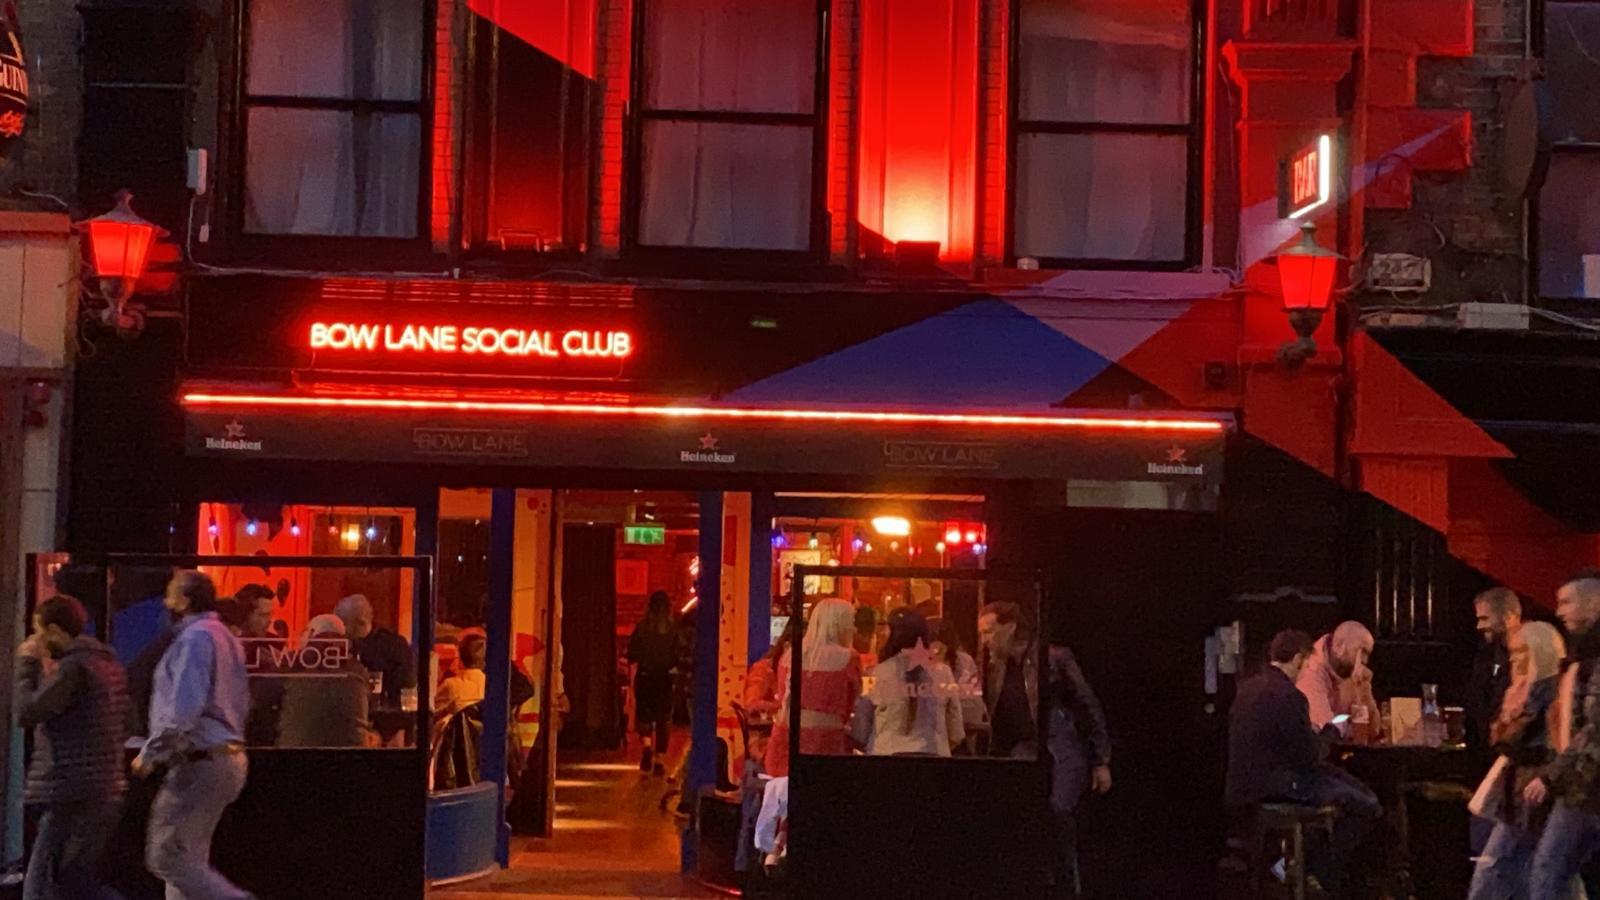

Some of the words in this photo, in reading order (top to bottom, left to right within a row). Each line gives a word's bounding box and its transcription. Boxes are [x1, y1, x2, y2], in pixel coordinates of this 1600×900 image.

[310, 322, 380, 350] BOW
[384, 324, 457, 351] LANE
[461, 326, 558, 357] SOCIAL
[562, 330, 632, 357] CLUB
[205, 437, 262, 451] Heineken
[418, 433, 466, 450] BOW
[472, 434, 525, 451] LANE
[680, 450, 736, 463] Heineken
[890, 446, 938, 463] BOW
